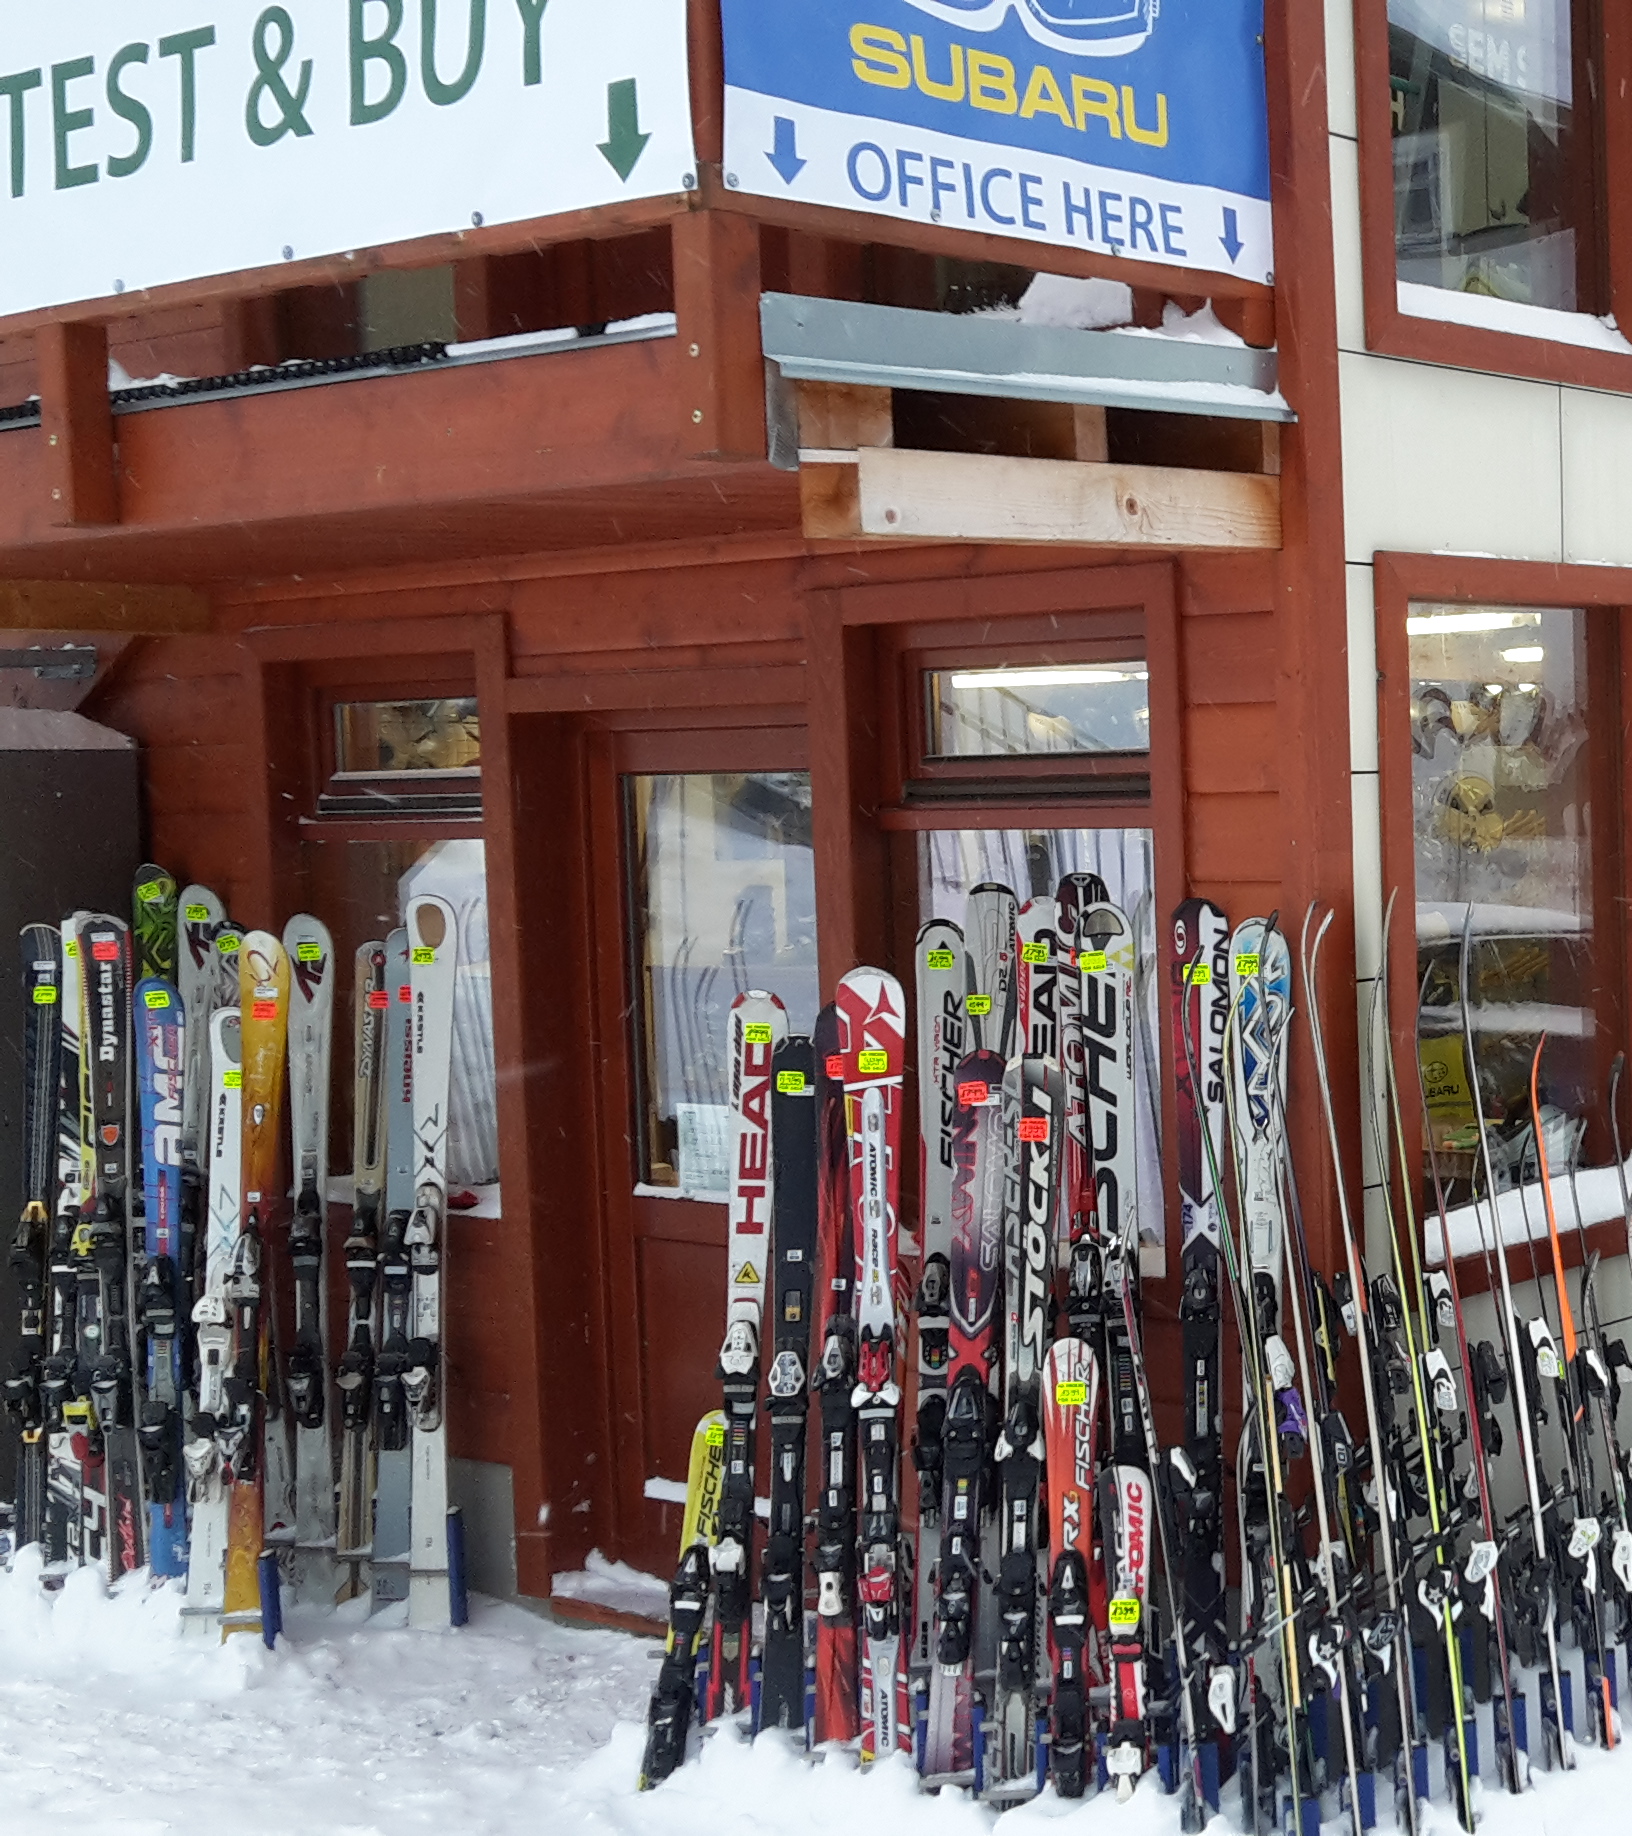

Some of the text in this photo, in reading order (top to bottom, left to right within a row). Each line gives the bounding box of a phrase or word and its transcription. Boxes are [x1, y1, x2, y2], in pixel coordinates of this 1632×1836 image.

[0, 0, 550, 198] TEST & BUY
[848, 22, 1168, 148] SUBARU
[846, 141, 1188, 258] OFFICE HERE
[1007, 901, 1016, 952] ATOMIC
[98, 961, 118, 1061] Dynastar
[1032, 928, 1058, 1059] EAD
[1055, 901, 1087, 1149] ATOMIC
[1207, 928, 1230, 1103] SALOMON
[735, 1041, 772, 1235] HEAD
[939, 990, 963, 1169] FISCHER
[1082, 973, 1118, 1238] SCHE
[1427, 1084, 1460, 1099] BARU
[869, 1142, 878, 1197] ATOMIC
[1074, 1361, 1091, 1491] FISCHR
[696, 1445, 722, 1538] FISCHE
[879, 1689, 890, 1747] ATOMIC
